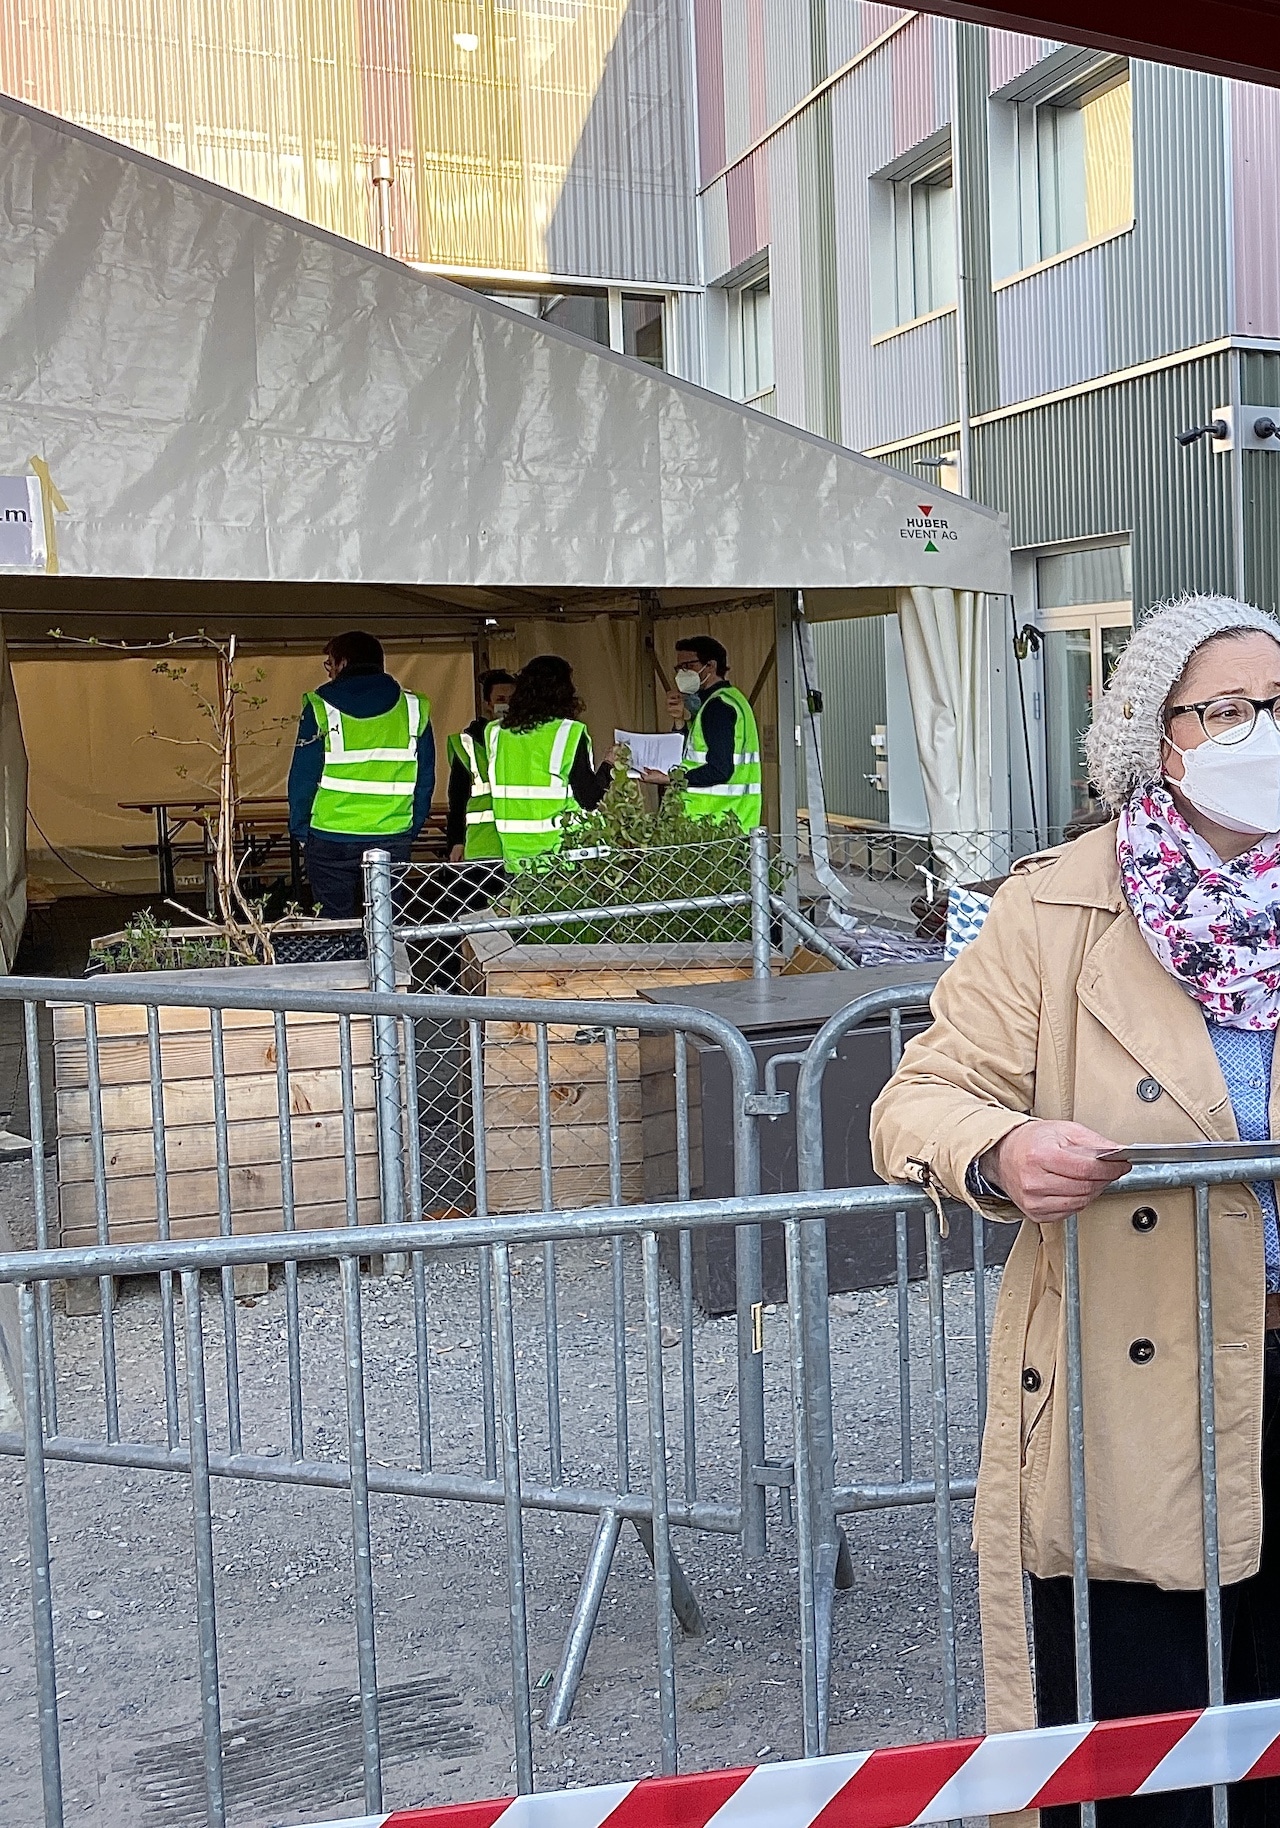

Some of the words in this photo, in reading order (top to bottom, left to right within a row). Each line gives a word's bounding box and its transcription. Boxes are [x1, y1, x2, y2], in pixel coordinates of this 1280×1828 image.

[906, 518, 949, 529] HUBER
[899, 529, 938, 539] EVENT
[941, 531, 958, 541] AG
